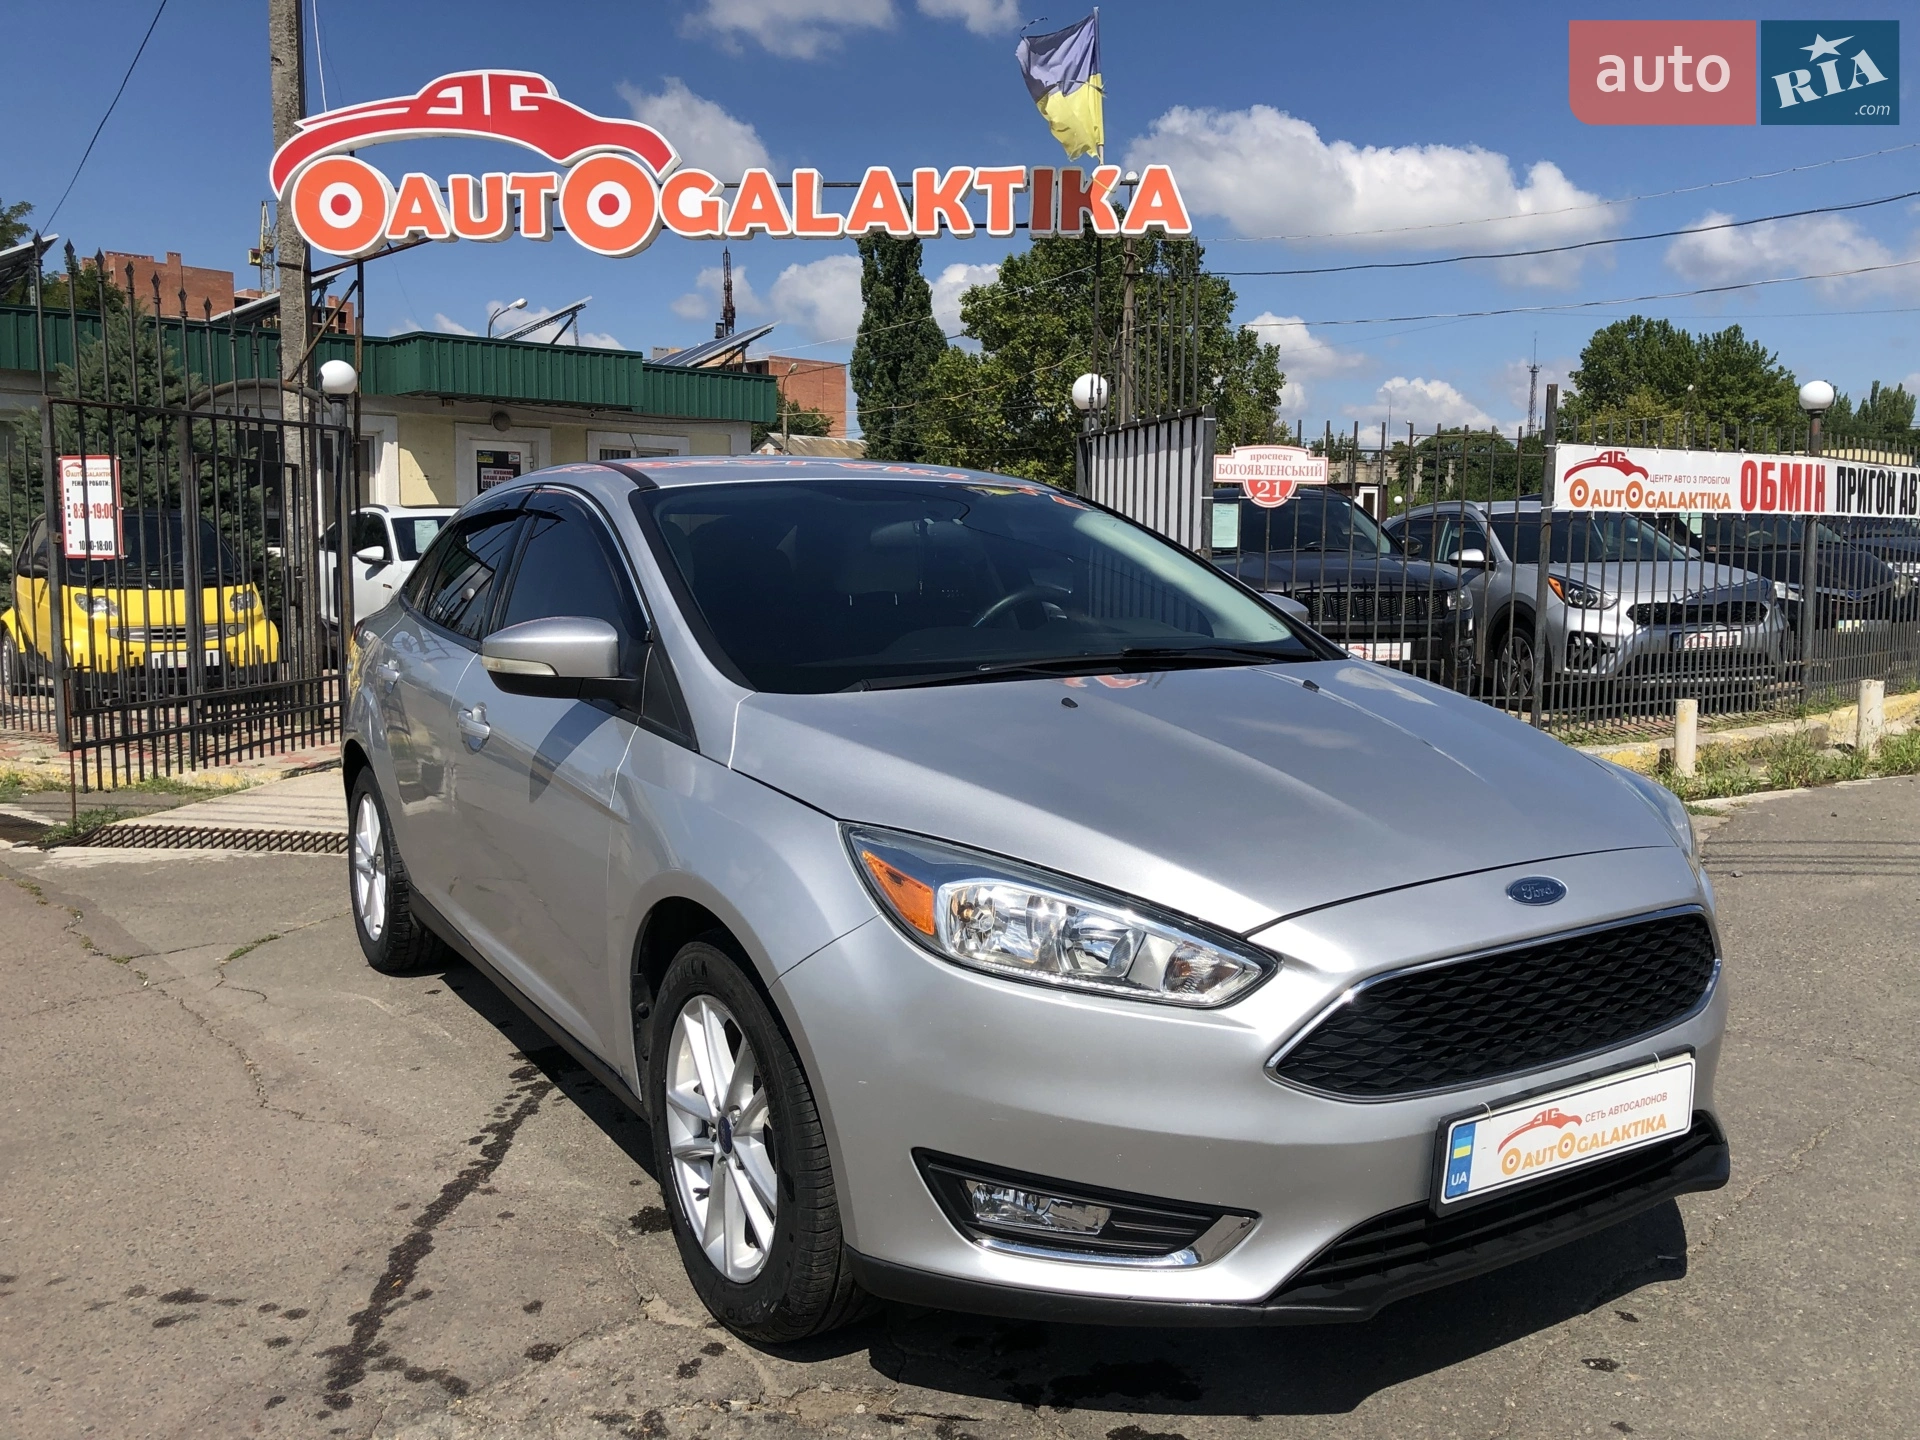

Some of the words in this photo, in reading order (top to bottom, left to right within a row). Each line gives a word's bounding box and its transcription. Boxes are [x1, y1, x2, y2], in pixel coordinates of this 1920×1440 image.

[1249, 453, 1293, 462] проспект
[1218, 463, 1323, 477] БОГОЯВЛЕНСЬКИЙ
[1649, 474, 1673, 484] ЦЕНТР
[1673, 475, 1691, 484] АВТО
[1698, 475, 1731, 485] ПРОБІГОМ
[1256, 480, 1283, 498] 21
[1740, 460, 1826, 513] ОБМІН
[1836, 466, 1897, 515] ПРИГОН
[1899, 472, 1920, 516] АВ
[1521, 881, 1555, 900] Ford
[1584, 1110, 1607, 1124] СЕТЬ
[1607, 1091, 1668, 1116] АВТОСАЛОНОВ
[1450, 1172, 1468, 1187] UA
